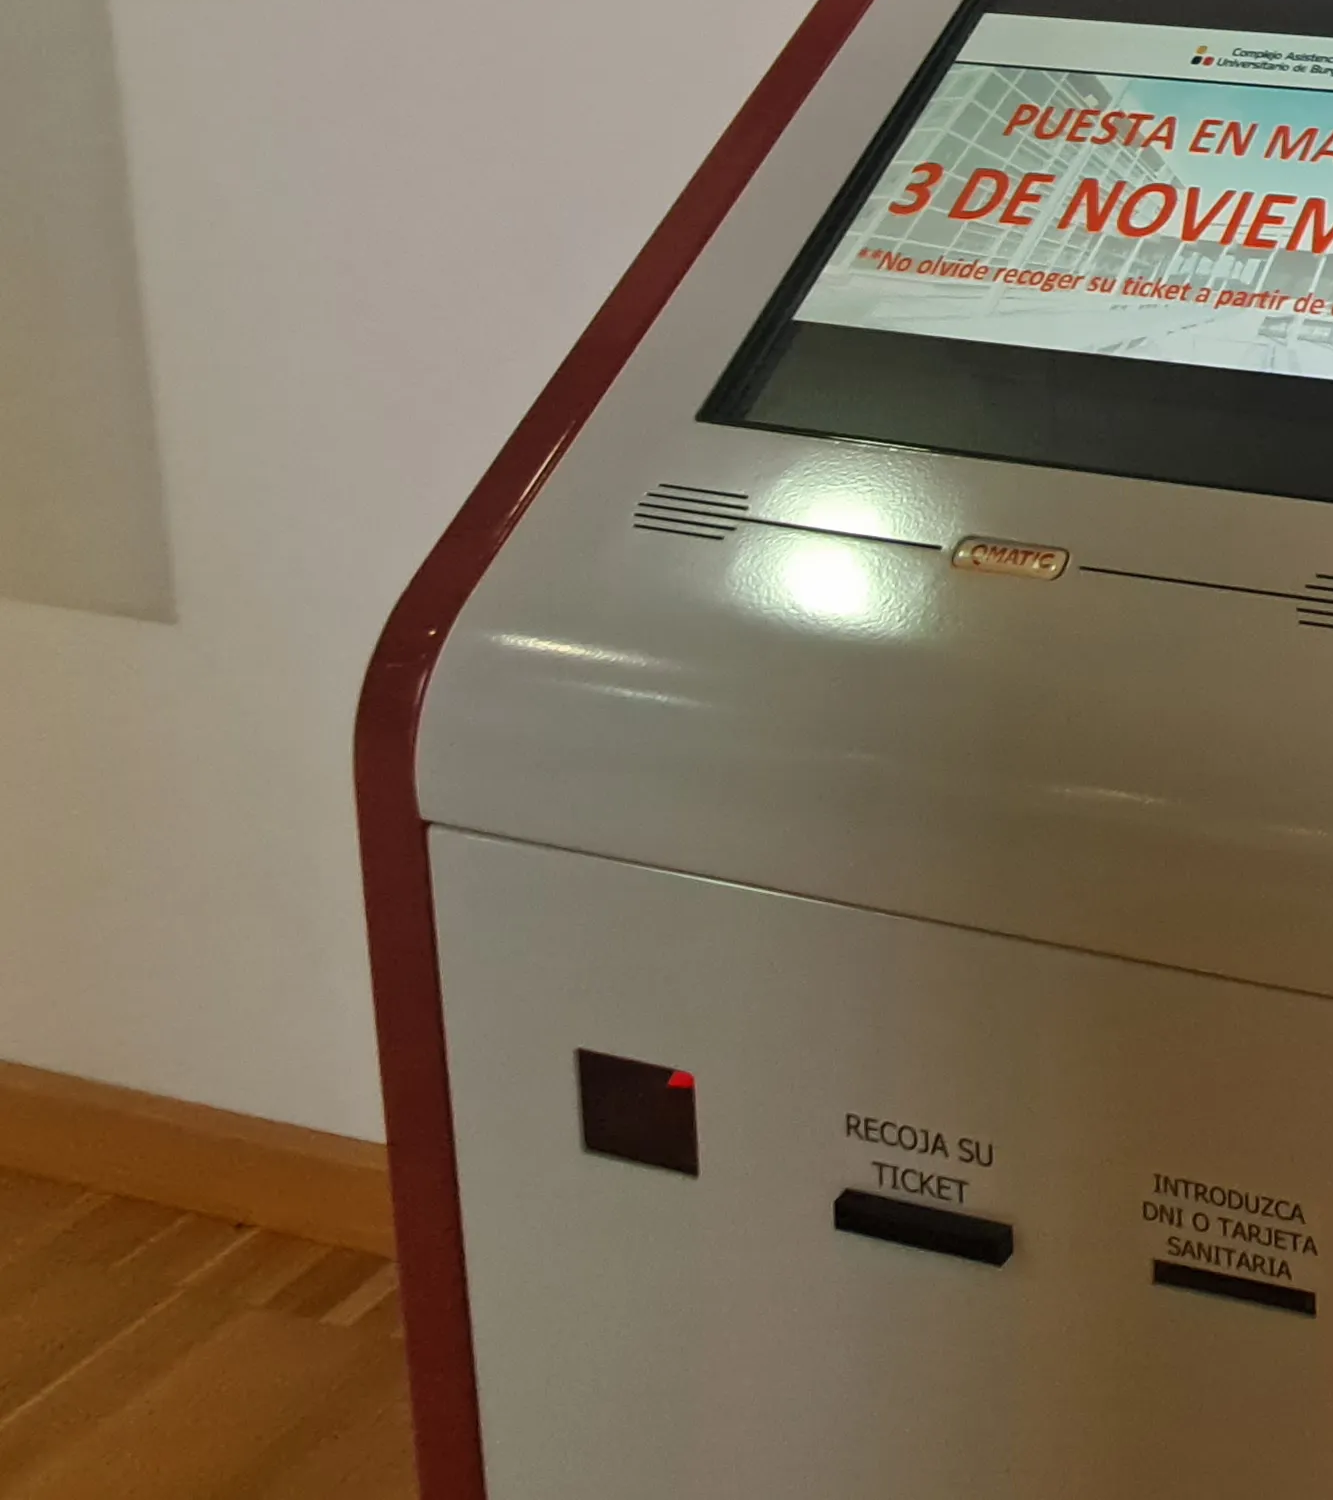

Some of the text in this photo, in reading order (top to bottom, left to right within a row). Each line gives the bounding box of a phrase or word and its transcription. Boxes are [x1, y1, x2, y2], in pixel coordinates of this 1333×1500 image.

[1216, 57, 1290, 72] Universitario
[1292, 63, 1306, 73] de
[1232, 47, 1282, 61] Complejo
[1002, 103, 1178, 151] PUESTA
[1189, 118, 1258, 157] EN
[887, 160, 945, 217] 3
[947, 167, 1056, 227] DE
[917, 255, 989, 281] olvide
[994, 267, 1086, 293] recoger
[1088, 274, 1116, 294] su
[1121, 275, 1192, 304] ticket
[1196, 285, 1212, 305] a
[1213, 286, 1289, 311] partir
[1293, 292, 1325, 316] de
[971, 544, 1056, 569] QMATIC
[845, 1112, 993, 1168] RECOJA SU
[871, 1161, 970, 1203] TICKET
[1153, 1173, 1307, 1225] INTRODUZCA
[1142, 1201, 1318, 1256] DNI O TARJETA
[1167, 1235, 1292, 1280] SANITARIA
